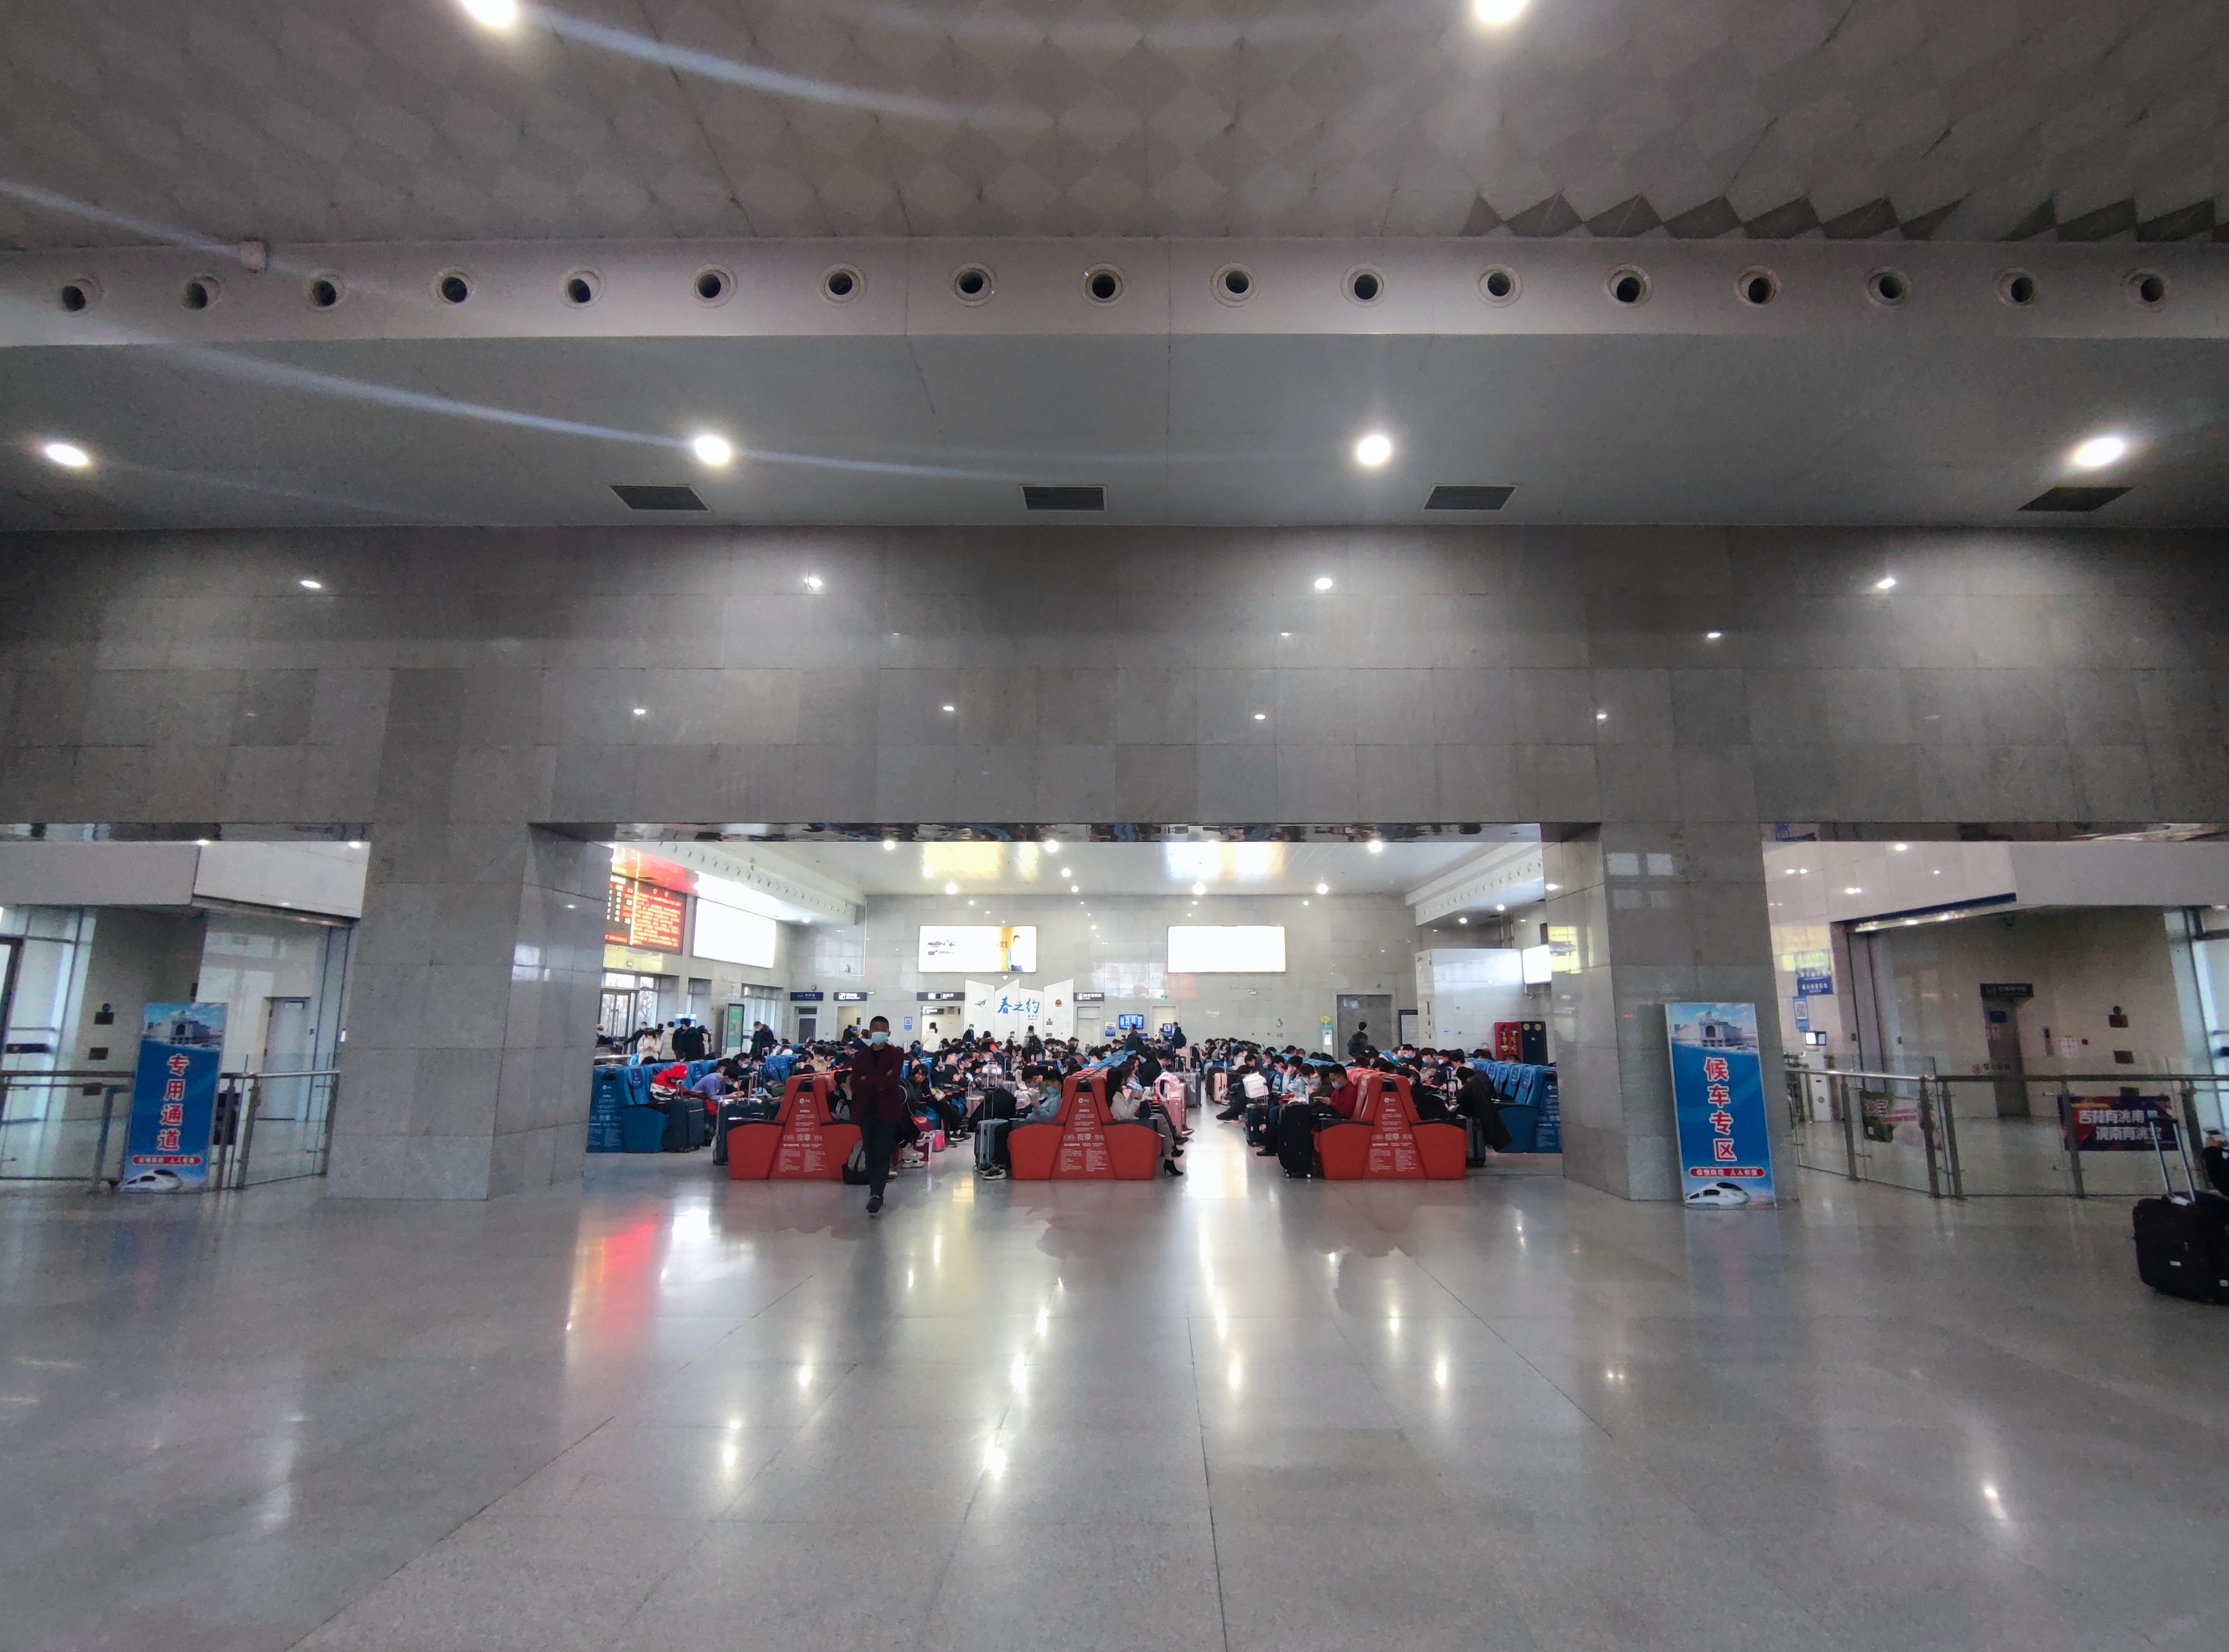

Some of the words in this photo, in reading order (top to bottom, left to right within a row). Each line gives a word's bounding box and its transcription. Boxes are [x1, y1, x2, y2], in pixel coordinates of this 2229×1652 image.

[998, 996, 1040, 1014] 春之约
[157, 1053, 190, 1151] 专用通道
[1703, 1057, 1737, 1162] 候车专区
